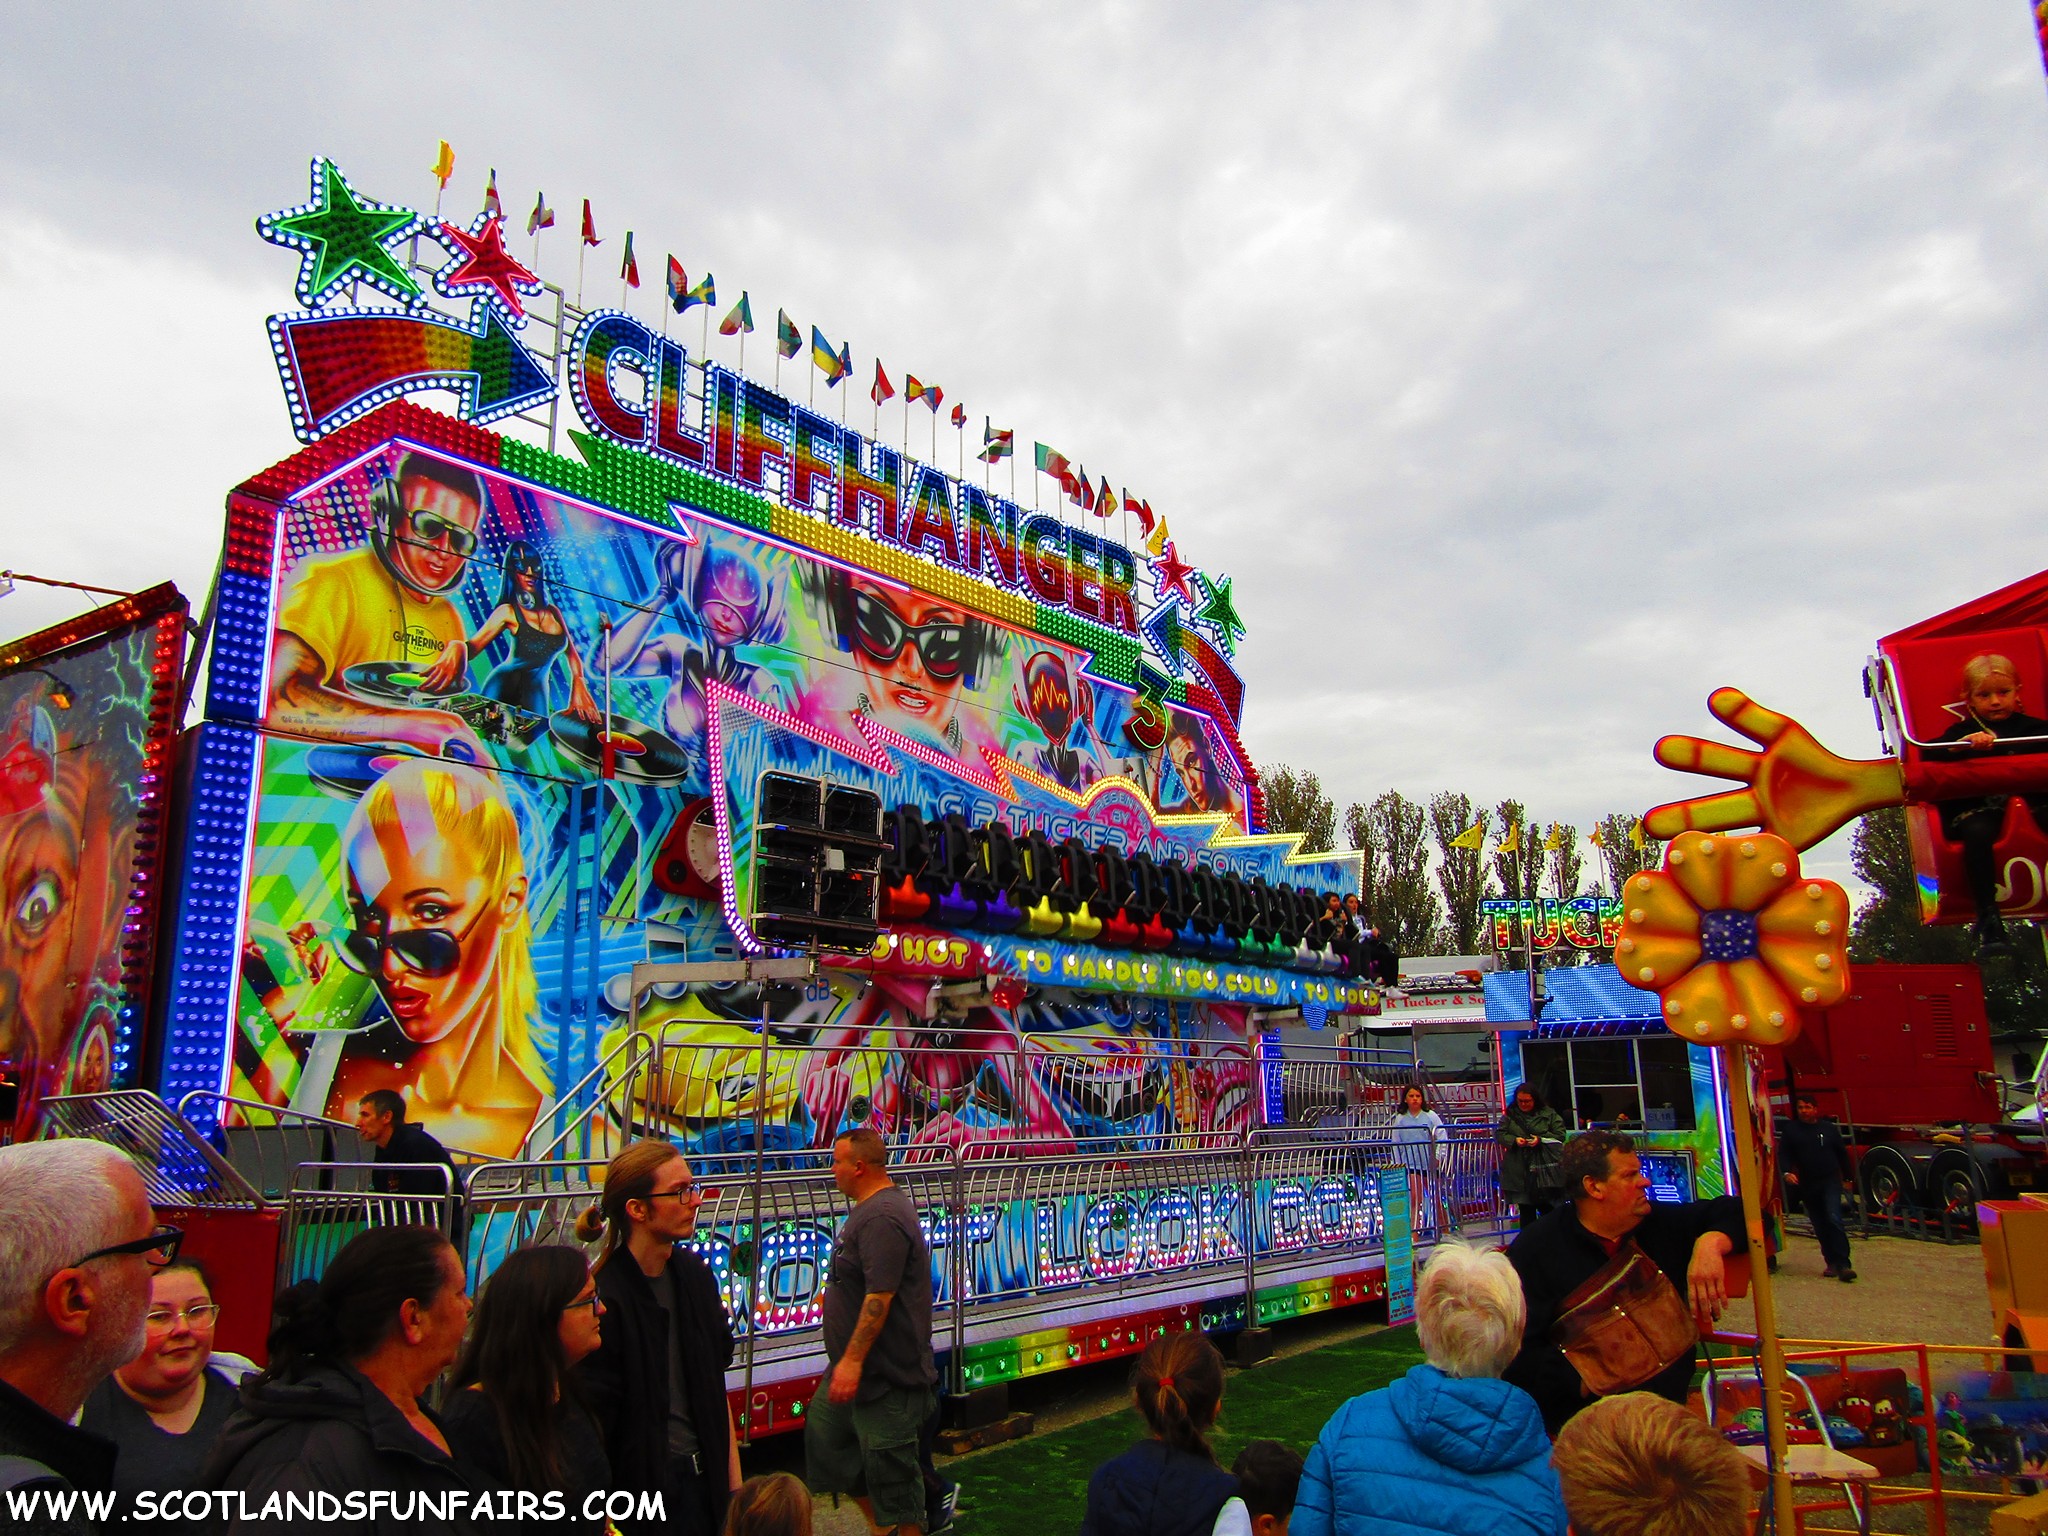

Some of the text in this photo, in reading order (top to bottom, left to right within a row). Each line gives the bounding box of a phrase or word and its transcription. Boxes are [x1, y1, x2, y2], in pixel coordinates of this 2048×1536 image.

[566, 307, 1144, 638] CLIFFHANGER
[393, 630, 445, 652] GATHERING
[1123, 659, 1173, 750] 3
[1006, 804, 1129, 858] TUCKER
[1135, 835, 1190, 868] AND
[1196, 848, 1261, 879] SONS
[1088, 790, 1152, 833] PRESENTED
[1112, 809, 1130, 826] BY
[902, 934, 970, 967] HOT
[1015, 949, 1053, 973] TO
[1062, 953, 1157, 985] HANDLE
[1172, 966, 1219, 990] TOO
[1226, 973, 1278, 996] COLD
[1304, 981, 1329, 1001] TO
[1335, 984, 1379, 1007] HOLD
[1386, 998, 1397, 1009] R
[1402, 996, 1448, 1008] Tucker
[1452, 994, 1465, 1006] &
[1035, 1185, 1244, 1294] LOOK
